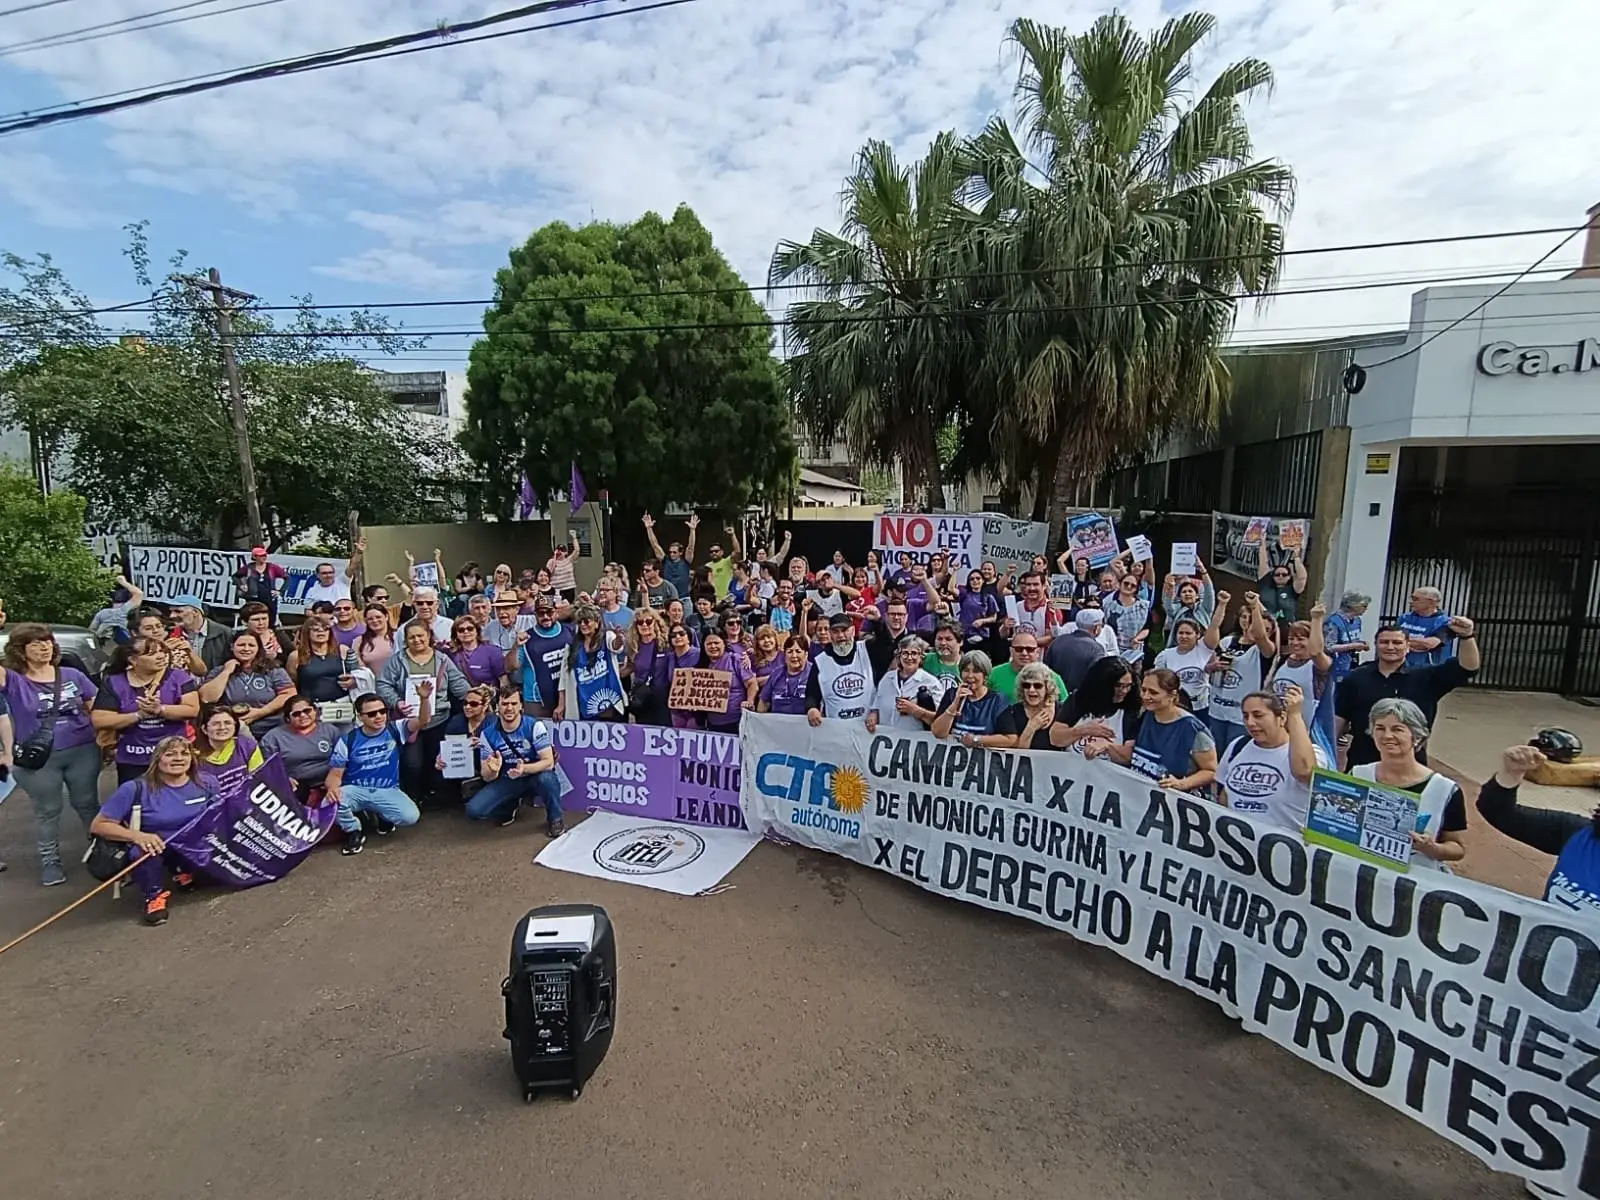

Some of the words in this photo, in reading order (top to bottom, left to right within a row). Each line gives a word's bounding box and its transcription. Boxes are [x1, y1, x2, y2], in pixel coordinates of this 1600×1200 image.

[880, 517, 933, 548] NO
[938, 519, 948, 531] A
[953, 519, 972, 532] LA
[938, 534, 971, 549] LEY
[132, 549, 150, 572] LA
[156, 550, 248, 577] PROTESTA
[146, 575, 164, 598] ES
[167, 575, 191, 599] UN
[671, 688, 685, 696] LA
[547, 720, 628, 751] TODOS
[584, 757, 647, 783] TODOS
[756, 753, 841, 812] CTA
[869, 735, 1033, 803] CAMPANA
[1046, 776, 1074, 813] X
[1083, 785, 1122, 828] LA
[586, 781, 649, 806] SOMOS
[250, 783, 320, 842] UDNAM
[676, 797, 748, 830] LEAND
[792, 807, 860, 840] autónoma
[1365, 832, 1405, 859] YA!!!
[873, 837, 892, 868] X
[900, 848, 929, 883] EL
[940, 842, 1132, 945] DERECHO
[1145, 910, 1172, 970] A
[1184, 925, 1238, 1006] LA
[876, 790, 899, 819] DE
[908, 792, 1004, 843] MONICA
[1013, 813, 1107, 875] GURINA
[1119, 850, 1137, 884] Y
[1140, 850, 1308, 959] LEANDRO
[1317, 928, 1600, 1103] SANCHEZ
